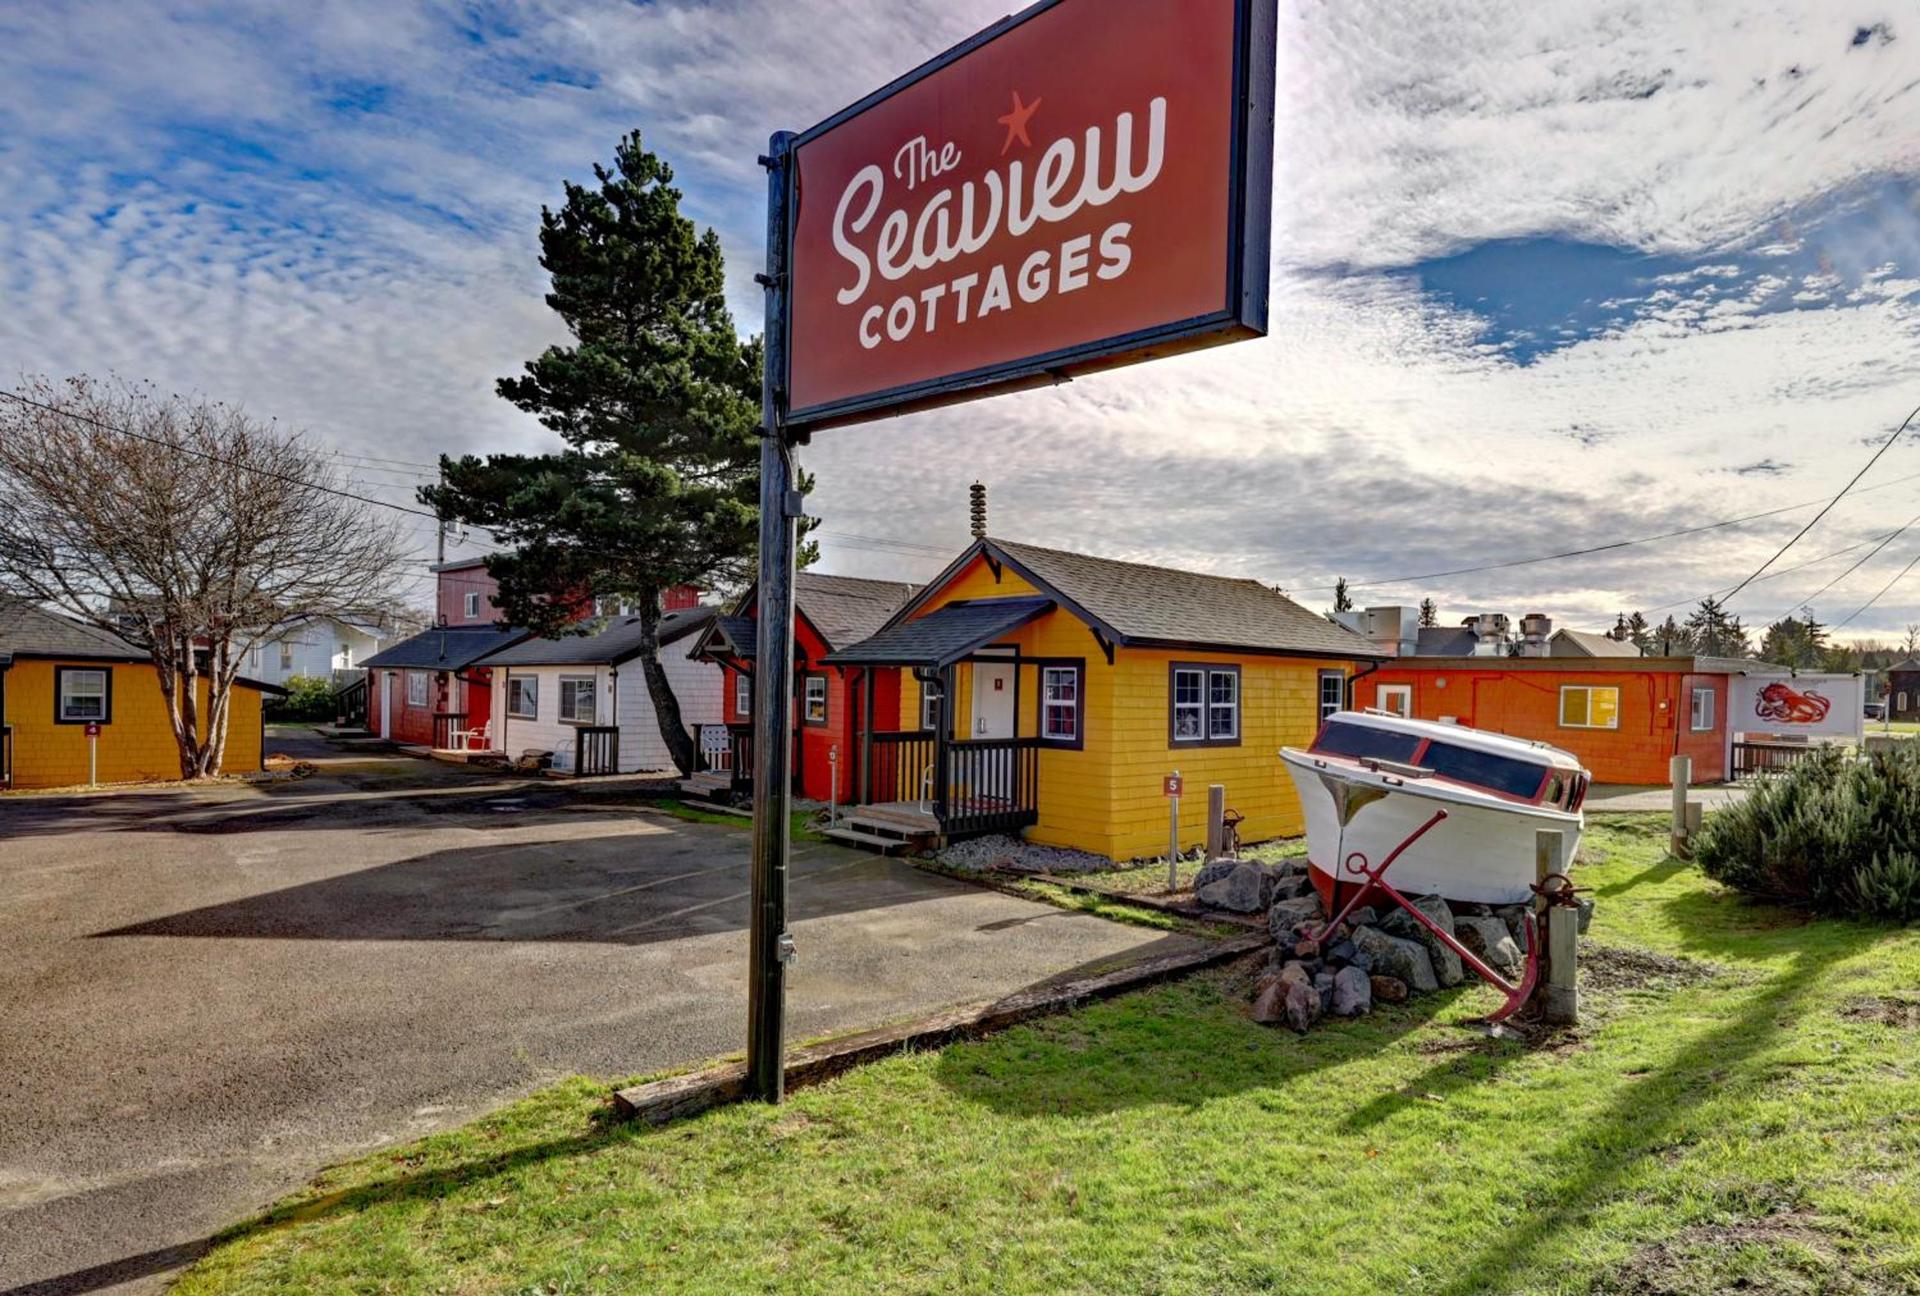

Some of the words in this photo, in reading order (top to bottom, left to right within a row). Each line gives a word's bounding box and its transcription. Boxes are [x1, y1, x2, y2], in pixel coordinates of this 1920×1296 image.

[832, 97, 1166, 304] Seaview
[894, 135, 961, 189] The
[859, 222, 1132, 349] COTTAGES
[1168, 779, 1177, 791] 5
